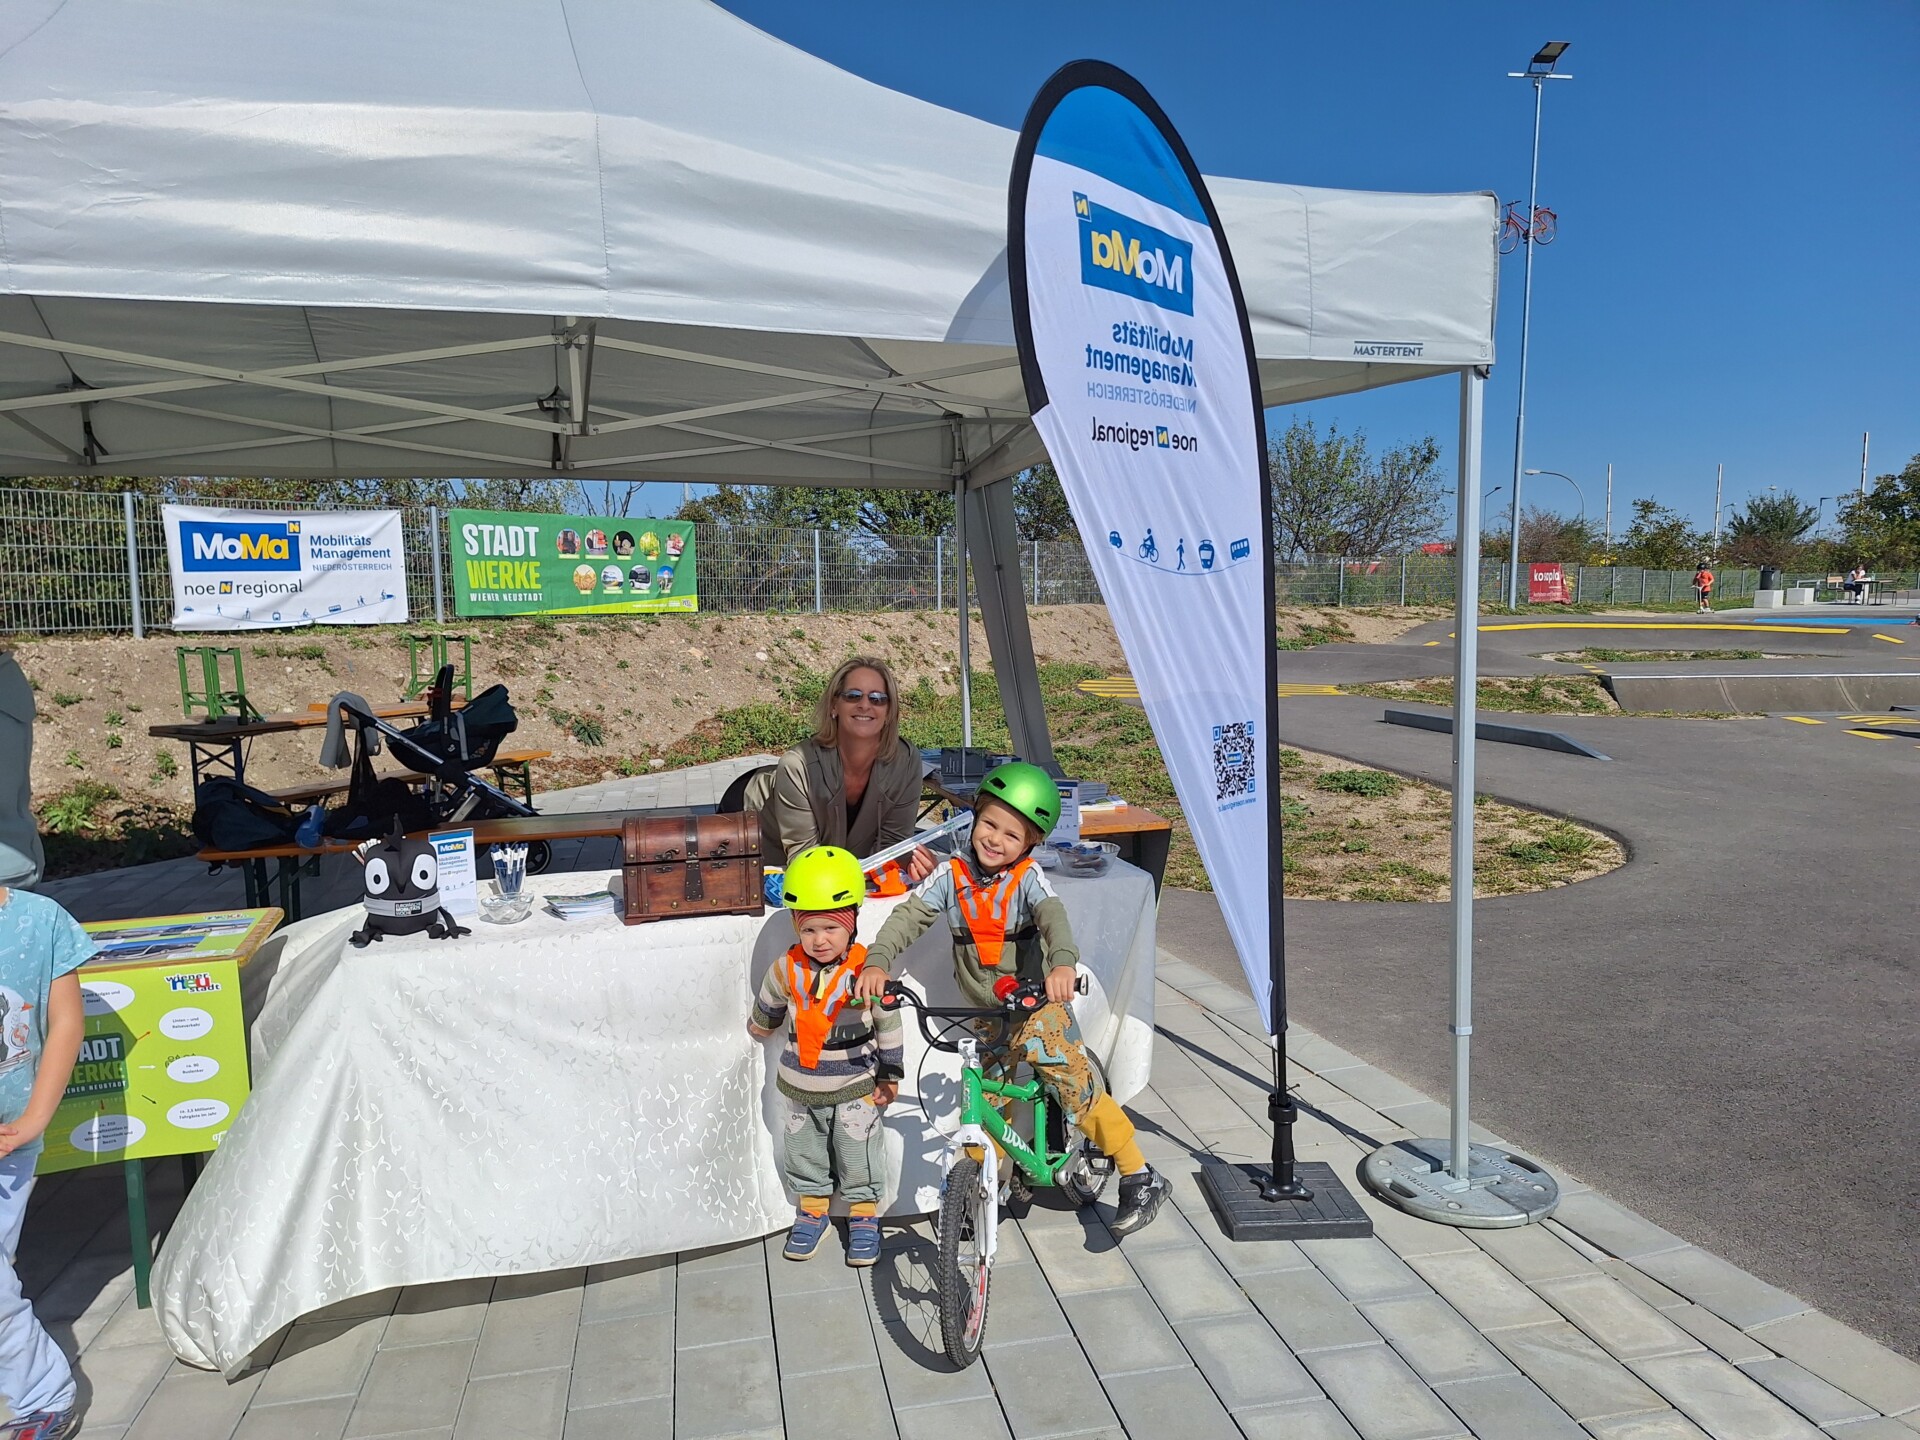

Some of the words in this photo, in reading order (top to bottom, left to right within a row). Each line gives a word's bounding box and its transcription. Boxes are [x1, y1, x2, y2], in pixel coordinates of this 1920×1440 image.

[1353, 345, 1423, 357] MASTERTENT
[192, 532, 289, 560] MoMa
[310, 535, 371, 547] Mobilitäts
[462, 523, 540, 557] STADT
[311, 548, 391, 561] Management
[312, 562, 392, 572] NIEDERÖSTERREICH
[466, 560, 542, 589] WERKE
[184, 585, 216, 596] noe
[236, 579, 303, 597] regional
[469, 592, 500, 602] WIENER
[502, 592, 543, 602] NEUSTADT
[440, 843, 465, 853] MoMa
[165, 973, 208, 982] wiener
[171, 977, 210, 990] neu
[189, 984, 220, 992] stadt
[79, 1038, 120, 1062] ADT
[69, 1061, 125, 1085] ERKE
[89, 1081, 126, 1090] NEUSTADT
